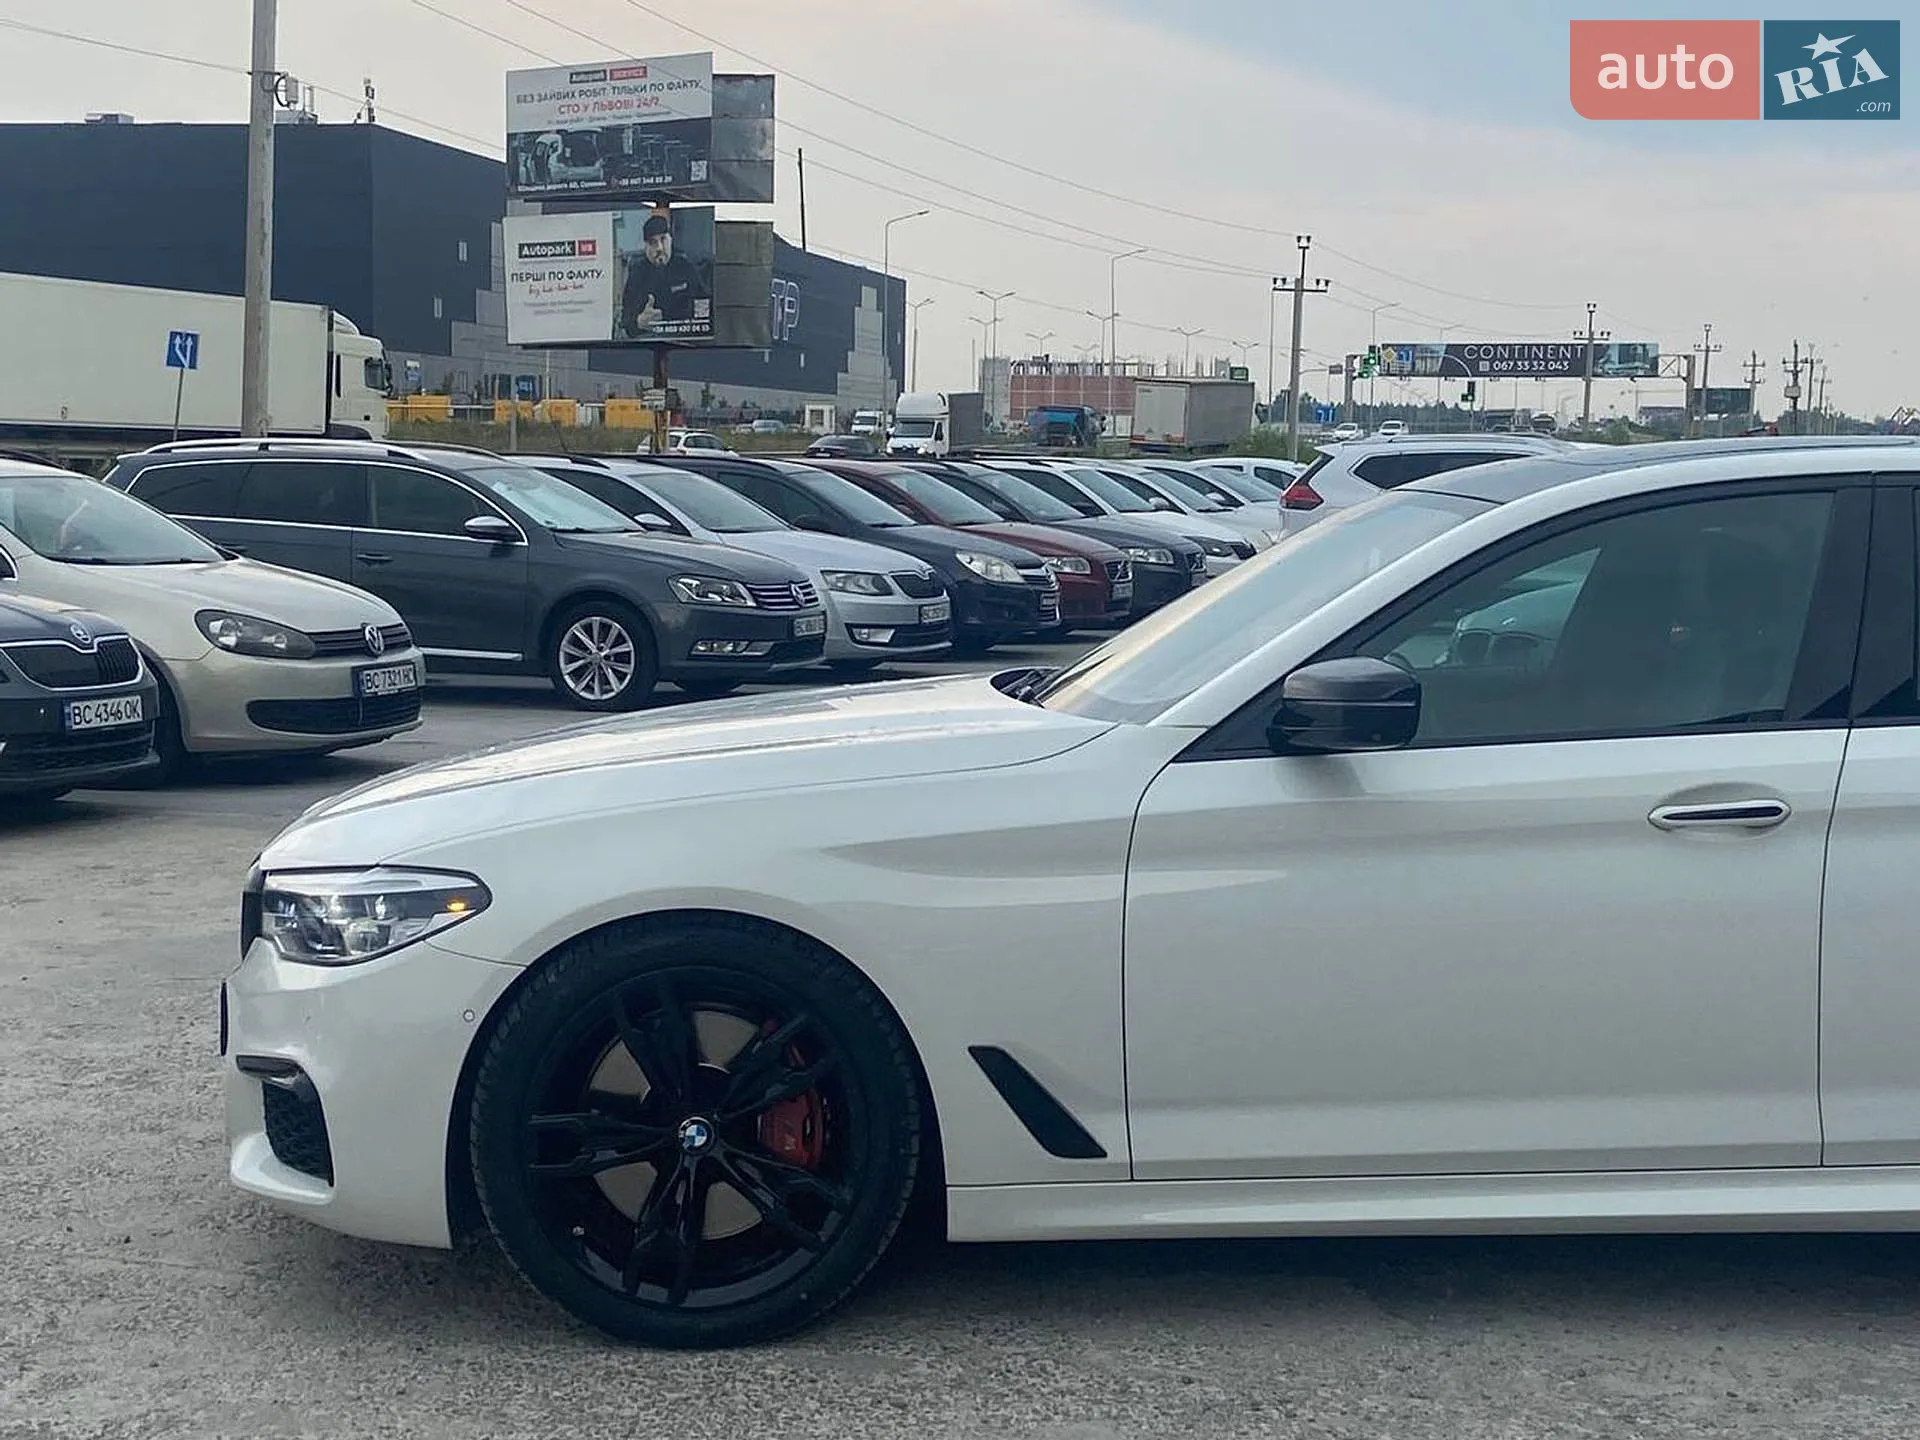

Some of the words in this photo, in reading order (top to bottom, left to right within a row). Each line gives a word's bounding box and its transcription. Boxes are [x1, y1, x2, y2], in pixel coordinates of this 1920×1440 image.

[649, 81, 665, 93] ПО
[558, 103, 580, 115] СТО
[582, 102, 590, 113] У
[522, 242, 572, 257] Autopark
[511, 272, 546, 283] ПЕРШІ
[548, 271, 564, 281] ПО
[1464, 345, 1585, 359] CONTINENT
[1492, 361, 1514, 371] 067
[1516, 361, 1530, 371] 33
[1548, 360, 1569, 371] 043
[365, 672, 380, 690] BC
[72, 705, 93, 726] BC
[95, 702, 123, 723] 4346
[124, 699, 141, 719] OK
